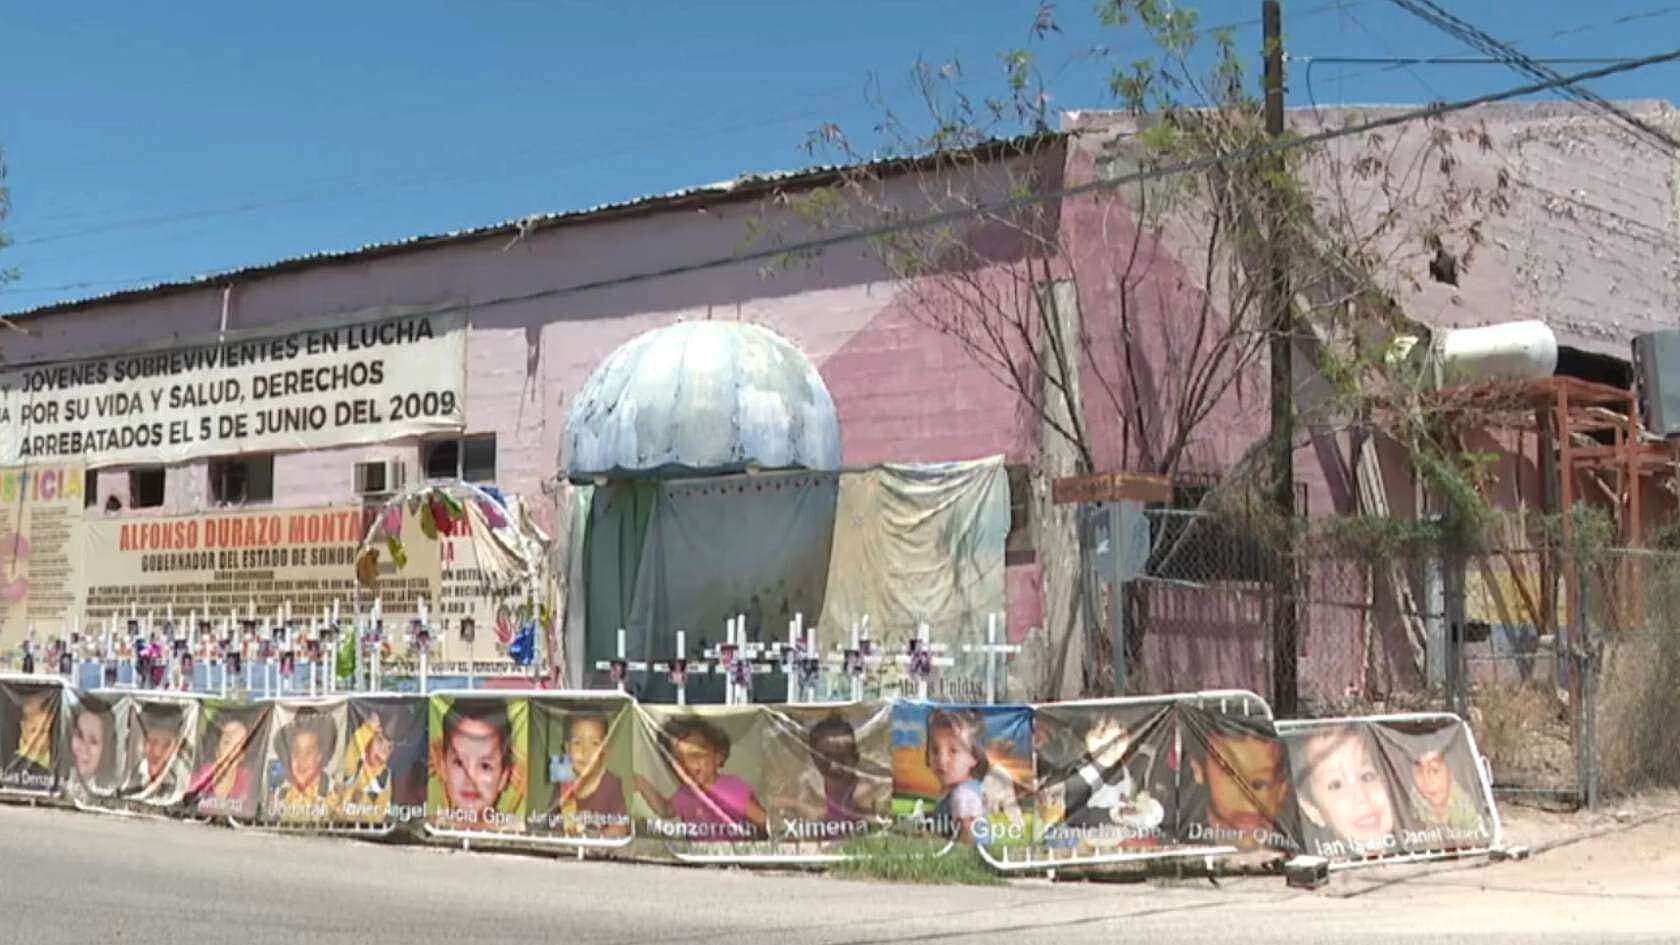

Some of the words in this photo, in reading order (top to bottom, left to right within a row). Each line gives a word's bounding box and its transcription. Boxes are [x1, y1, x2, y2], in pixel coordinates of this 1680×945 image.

[22, 361, 108, 393] JOVENES
[114, 337, 300, 383] SOBREVIVIENTES
[307, 331, 339, 354] EN
[347, 316, 434, 351] LUCHA
[21, 401, 59, 426] POR
[64, 397, 90, 422] SU
[96, 389, 144, 418] VIDA
[151, 387, 163, 410] Y
[169, 377, 247, 409] SALUD,
[253, 359, 385, 401] DERECHOS
[18, 422, 163, 459] ARREBATADOS
[168, 420, 194, 446] EL
[199, 416, 212, 442] 5
[218, 412, 248, 439] DE
[254, 404, 326, 436] JUNIO
[334, 397, 382, 427] DEL
[389, 389, 457, 422] 2009
[119, 518, 199, 551] ALFONSO
[205, 514, 283, 549] DURAZO
[141, 551, 216, 572] GOBERNADOR
[219, 550, 240, 571] DEL
[242, 548, 288, 569] ESTADO
[291, 547, 306, 566] DE
[783, 817, 869, 838] Ximena
[1188, 821, 1246, 841] Daher
[1315, 837, 1346, 857] Ian
